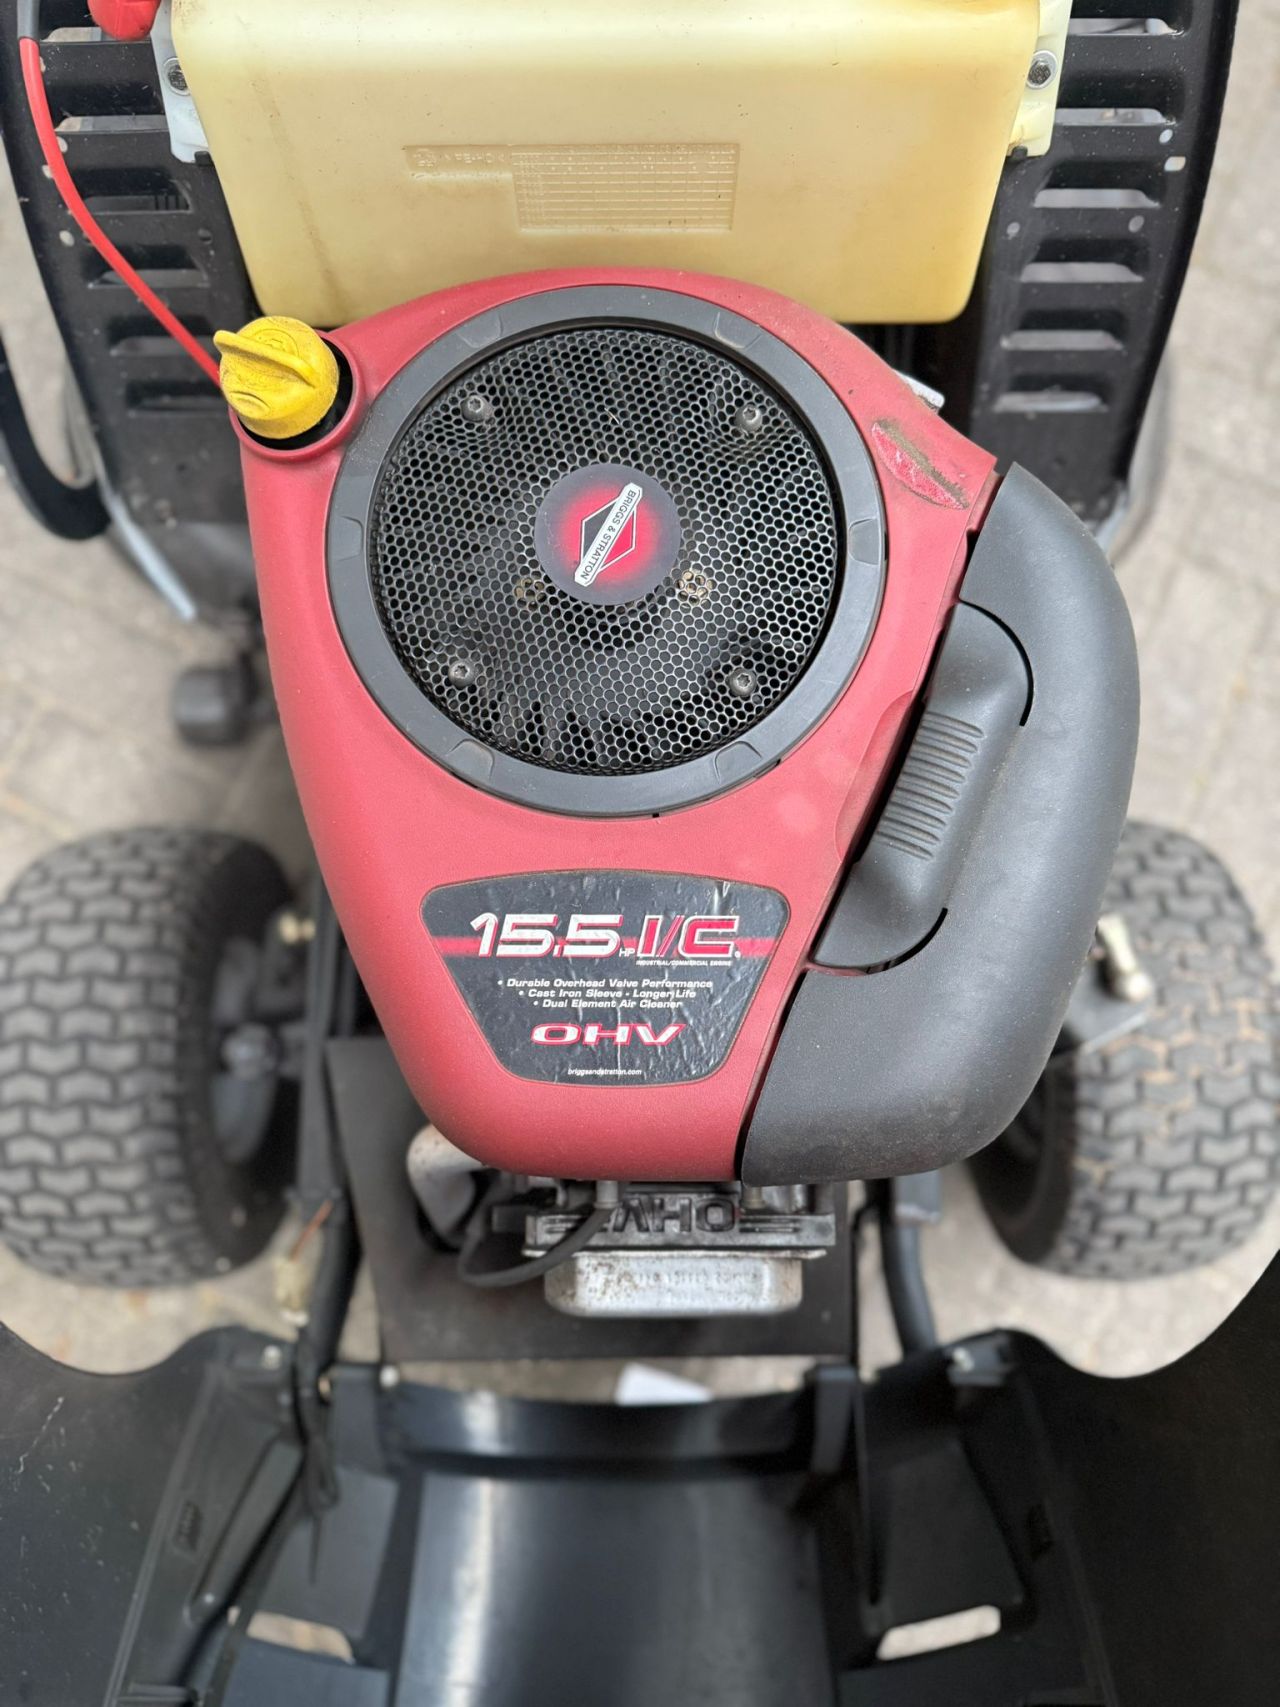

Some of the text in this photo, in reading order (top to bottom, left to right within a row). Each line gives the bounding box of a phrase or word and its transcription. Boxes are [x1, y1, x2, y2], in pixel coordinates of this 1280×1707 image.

[580, 489, 637, 581] BRIGGS & STRATTON
[469, 911, 623, 958] 15.5
[619, 948, 636, 957] HP
[506, 978, 714, 989] Durable Overhead Valve Performance
[528, 988, 556, 998] Cast
[559, 988, 582, 998] Iron
[585, 988, 623, 998] Sleeve
[632, 988, 673, 1000] Longer
[675, 988, 697, 998] Life
[542, 999, 683, 1009] Dual Element Air Cleaner
[531, 1022, 687, 1046] OHV
[567, 1068, 643, 1078] briggsandstratton.com
[612, 1194, 738, 1234] OHV
